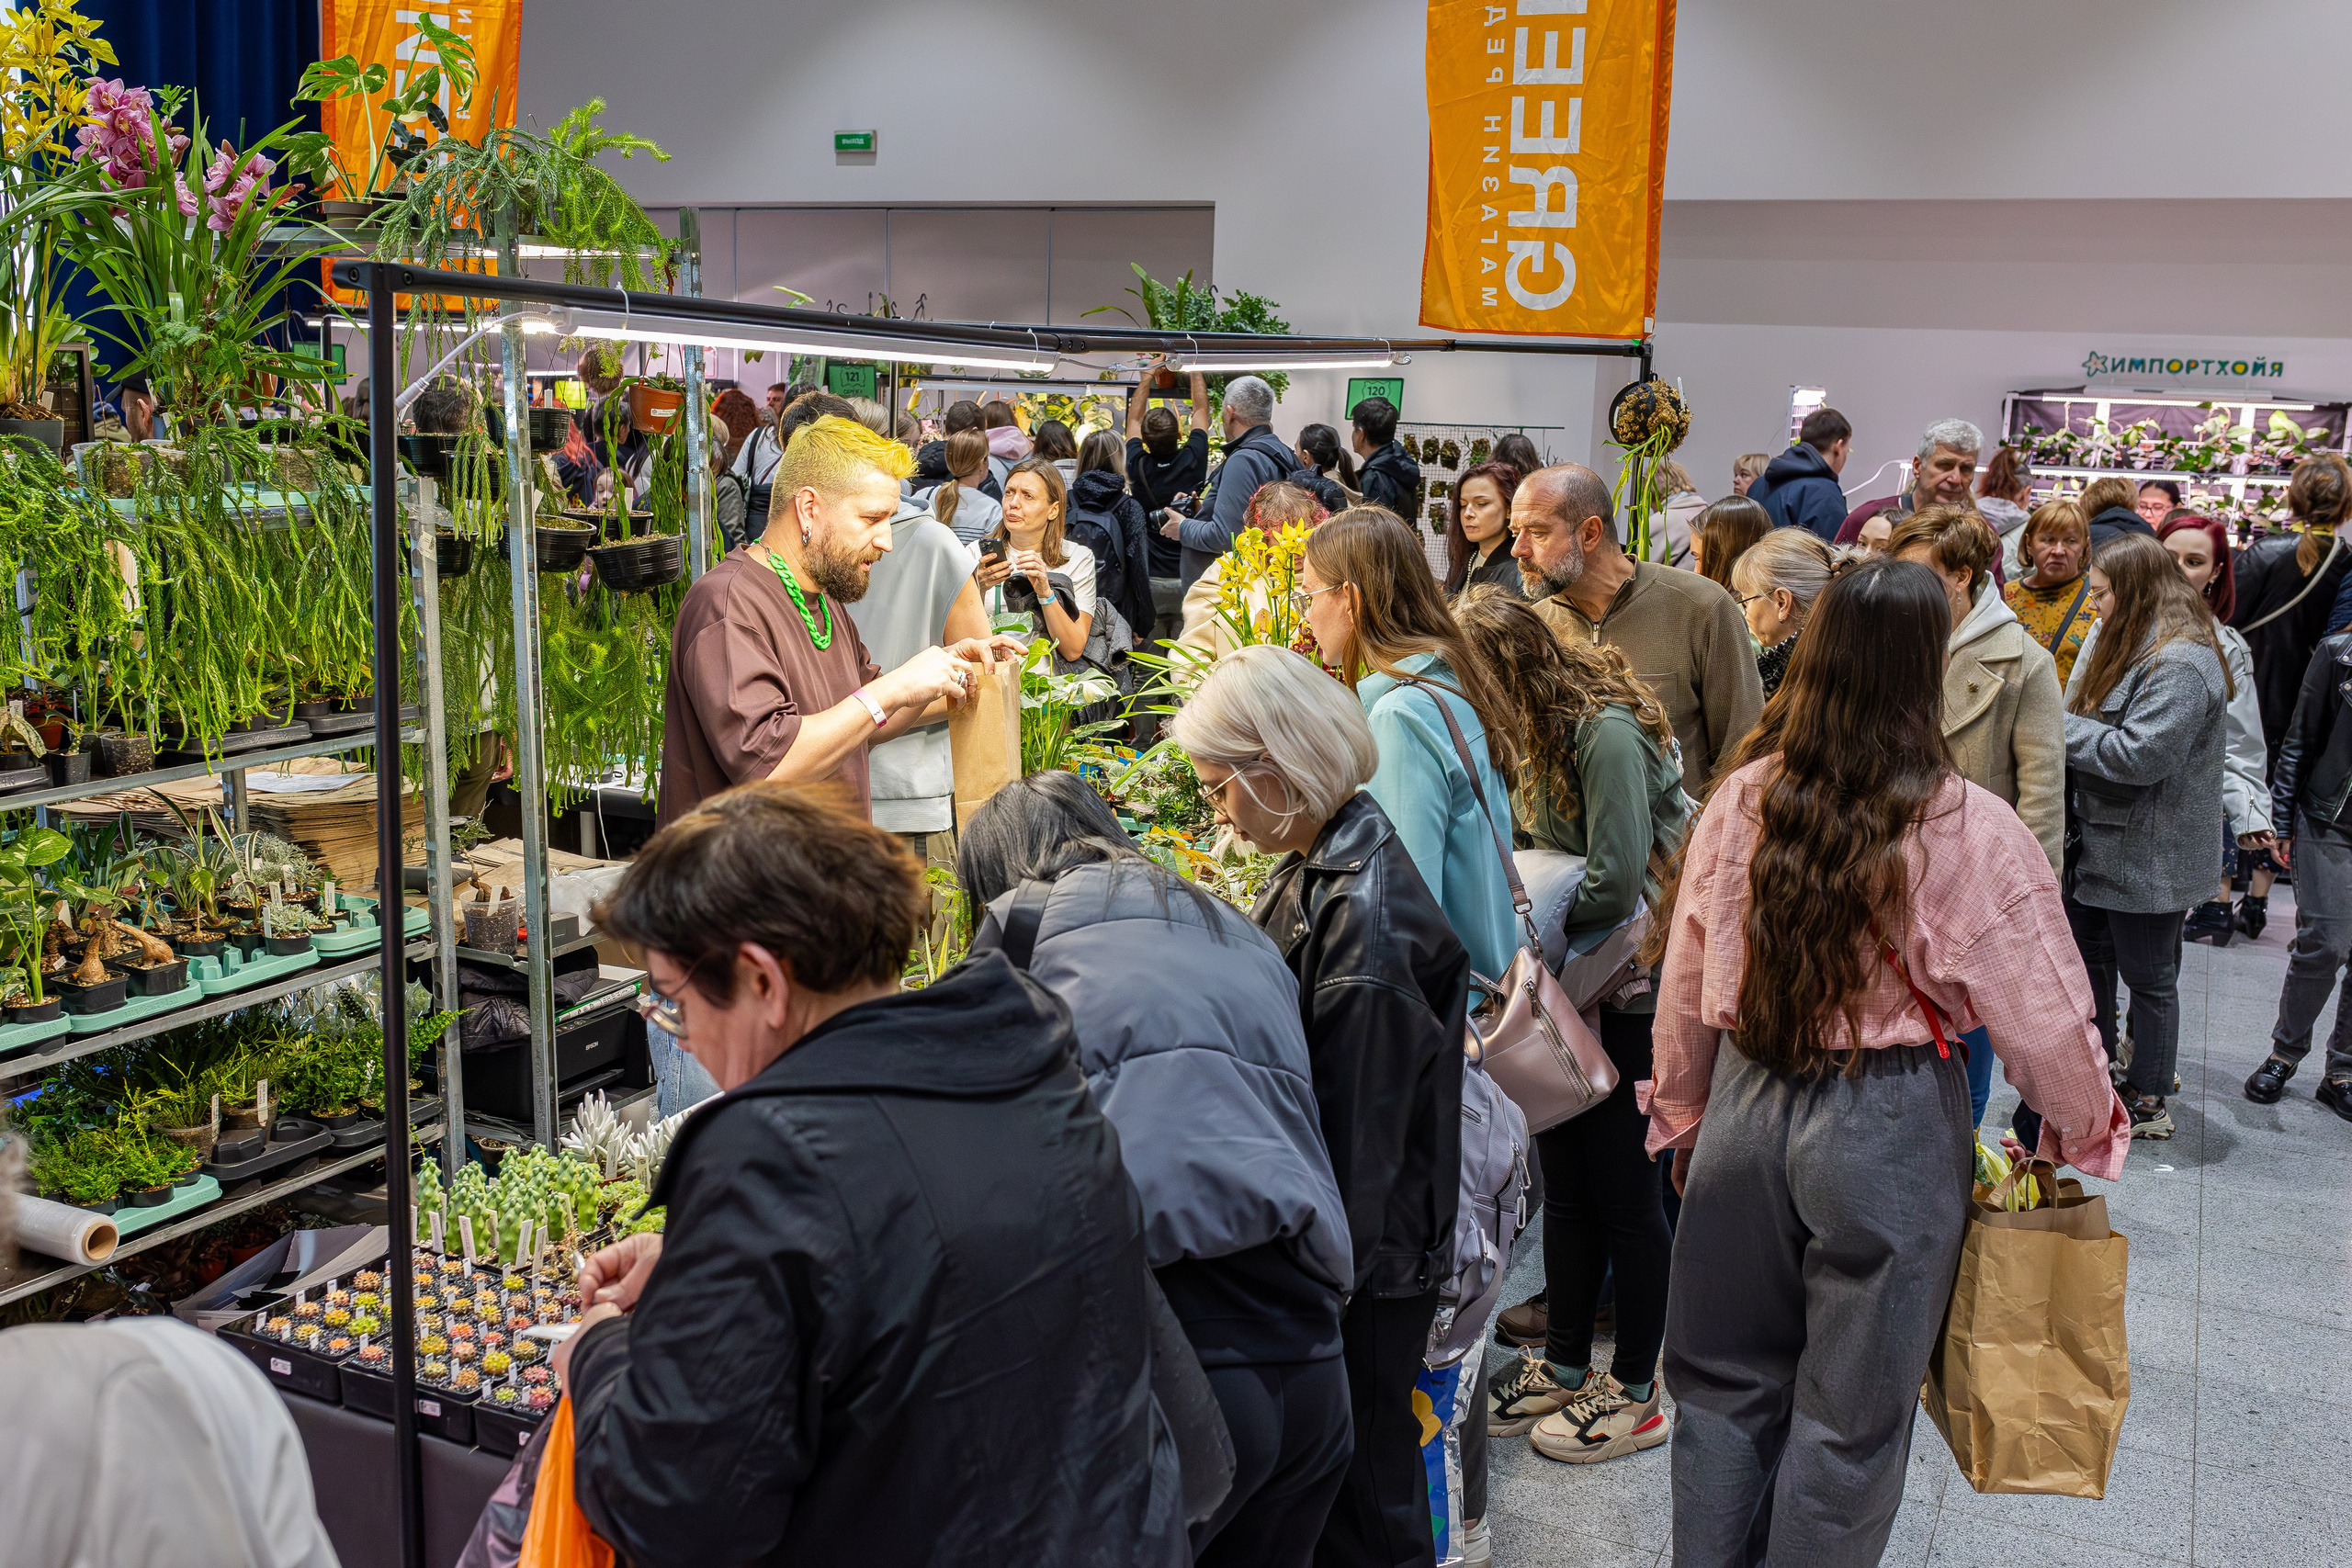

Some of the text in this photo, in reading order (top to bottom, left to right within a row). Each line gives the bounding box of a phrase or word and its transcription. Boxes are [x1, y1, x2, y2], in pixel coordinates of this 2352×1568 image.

[2110, 355, 2284, 378] ИМПОРТХОЙЯ
[845, 371, 860, 382] 121
[1367, 386, 1385, 396] 120
[585, 1041, 599, 1051] EPSON
